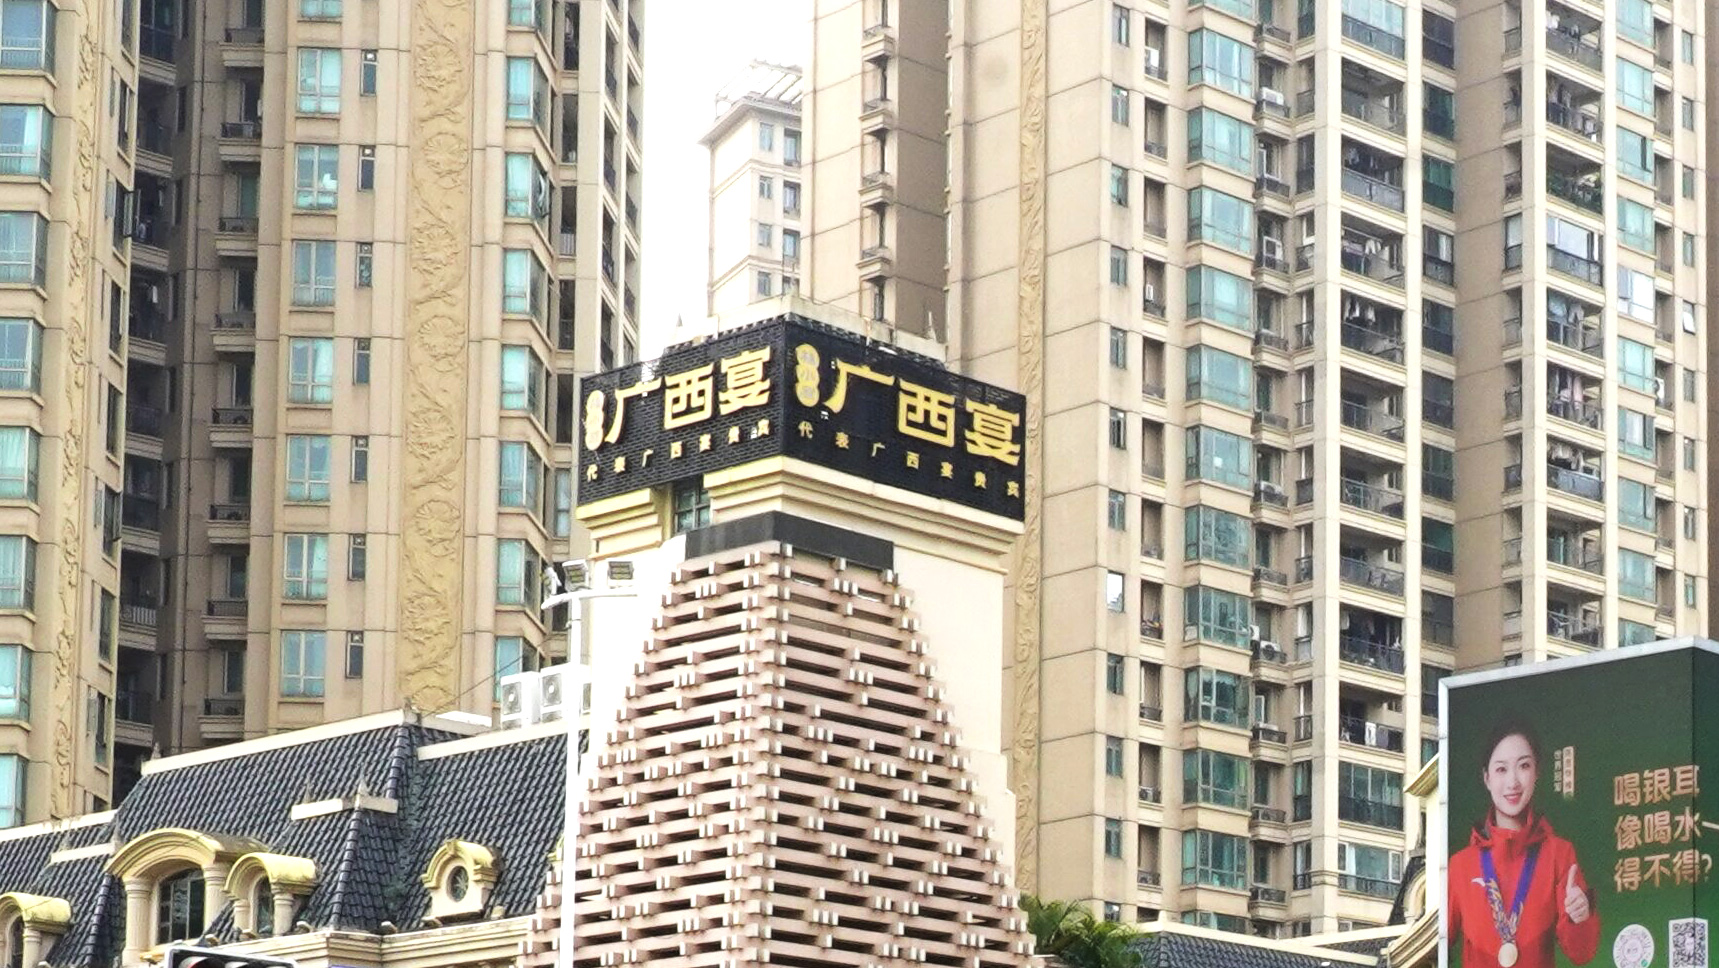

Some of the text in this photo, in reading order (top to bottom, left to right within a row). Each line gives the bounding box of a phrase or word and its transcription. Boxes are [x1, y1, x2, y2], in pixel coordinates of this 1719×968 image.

[604, 346, 771, 445] 广西宴
[822, 358, 1021, 466] 广西宴
[1614, 764, 1700, 806] 喝银耳
[1614, 849, 1713, 893] 得不得?
